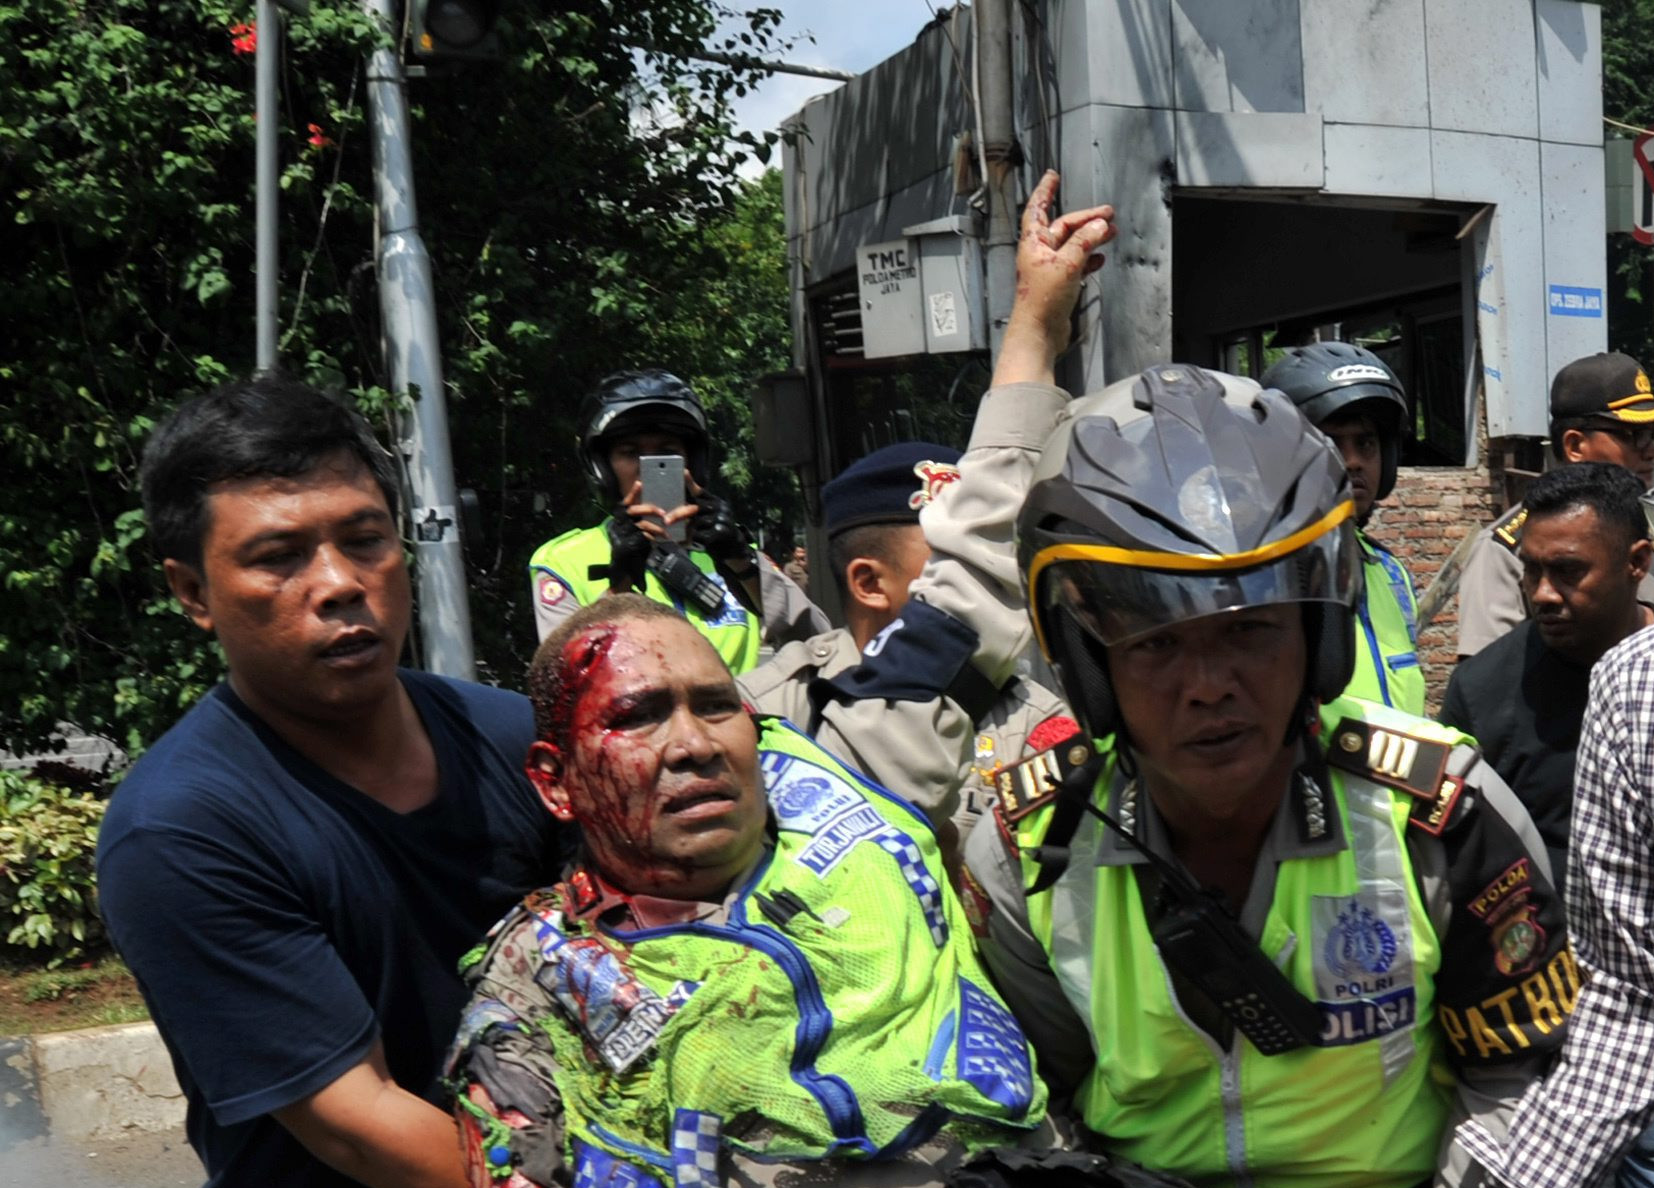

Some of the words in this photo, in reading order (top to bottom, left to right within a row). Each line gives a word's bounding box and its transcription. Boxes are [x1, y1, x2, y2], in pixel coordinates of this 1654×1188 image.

[868, 249, 906, 269] TMC
[1474, 863, 1528, 914] POLDA
[1335, 977, 1393, 997] POLRI
[1321, 996, 1409, 1041] OLISI
